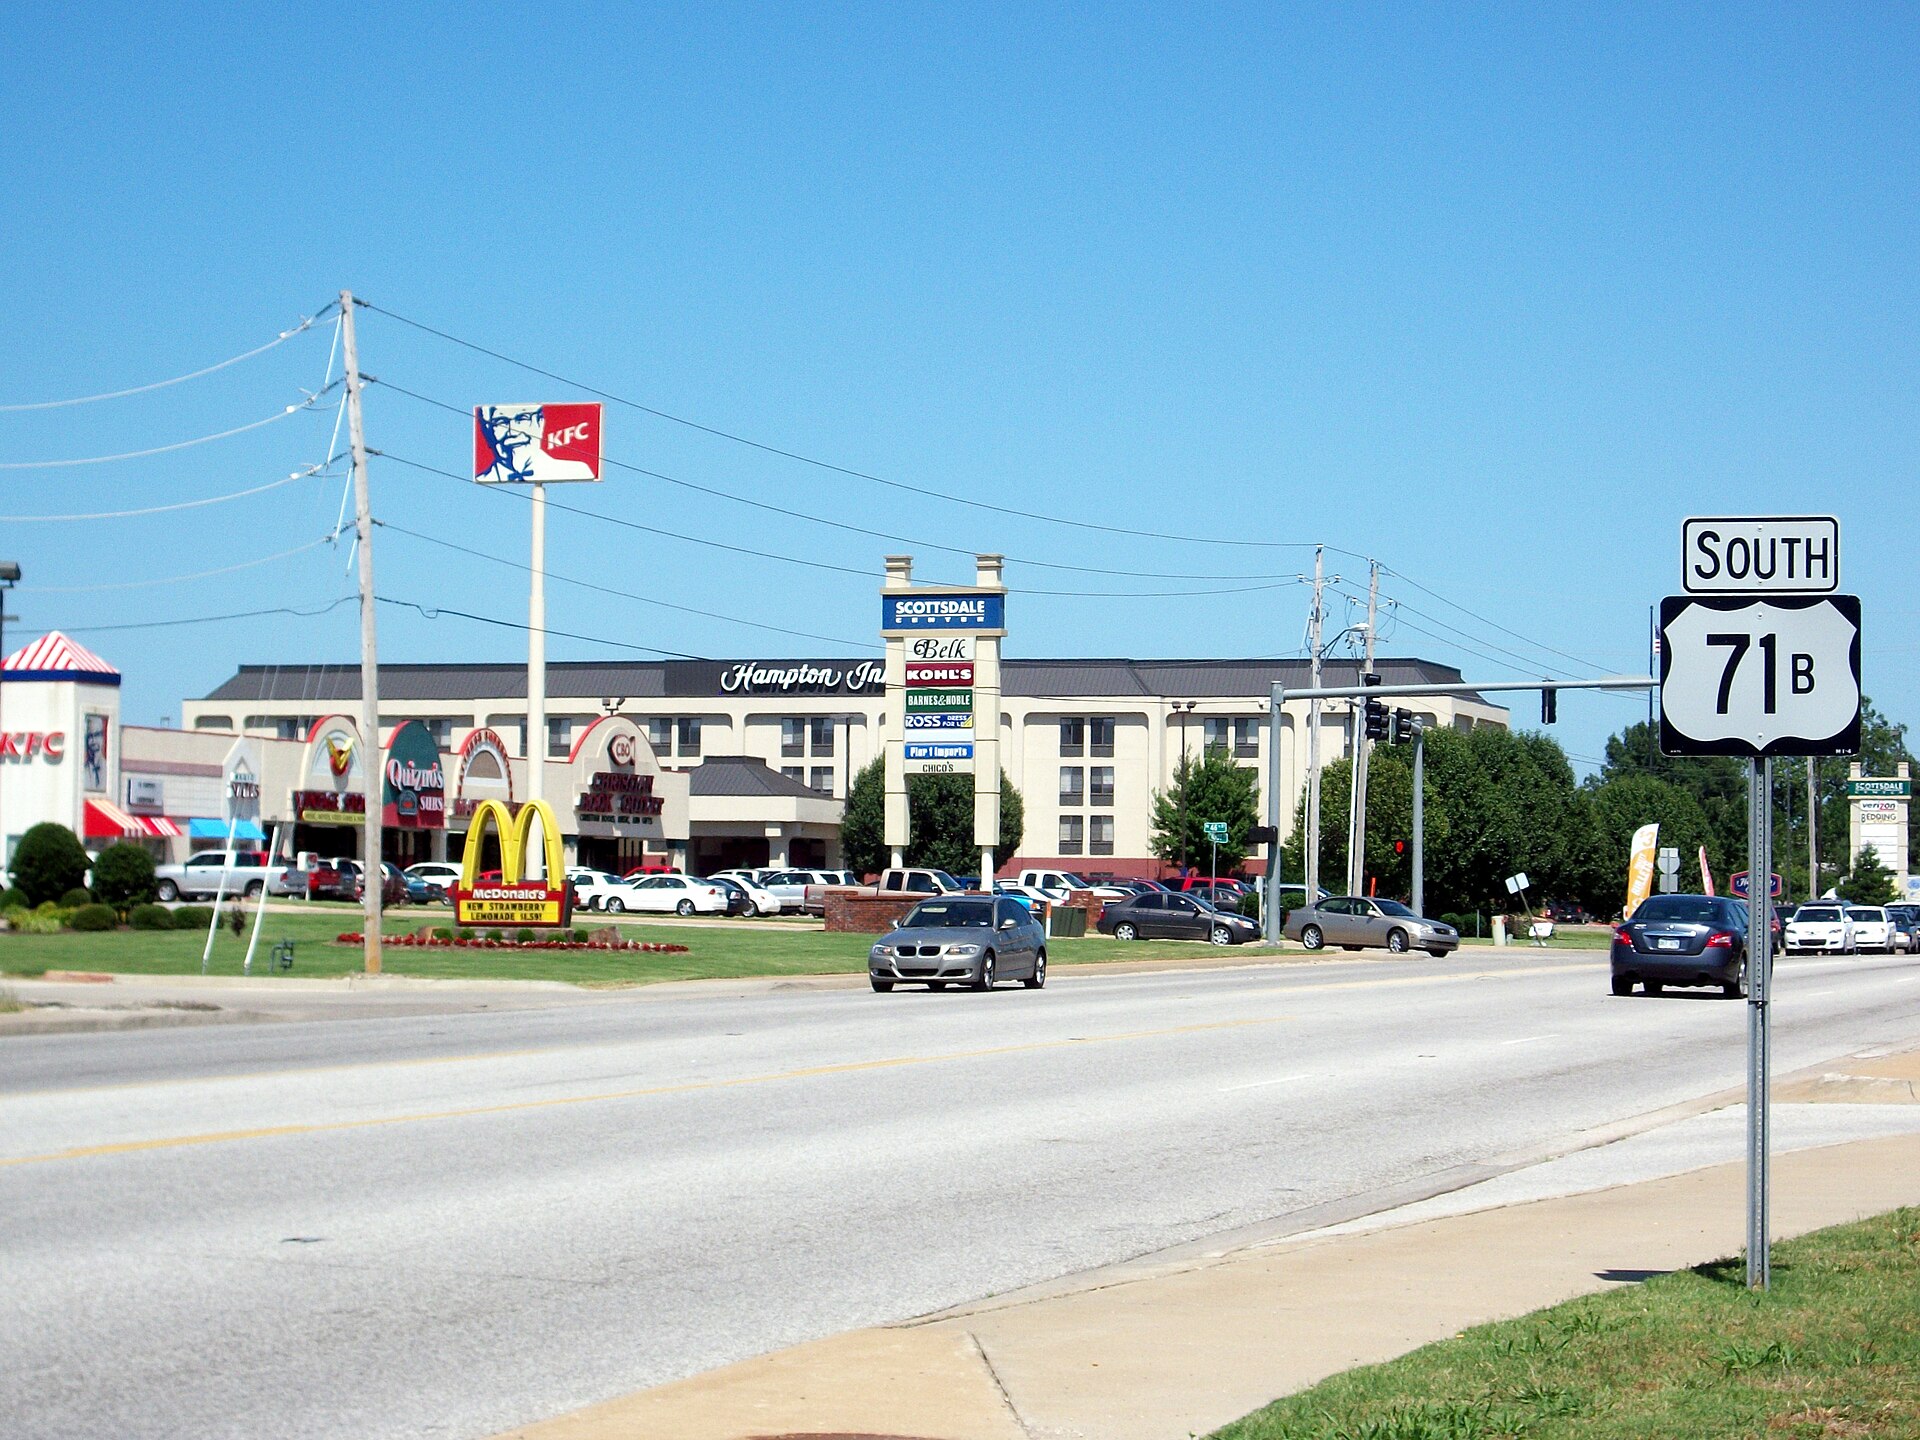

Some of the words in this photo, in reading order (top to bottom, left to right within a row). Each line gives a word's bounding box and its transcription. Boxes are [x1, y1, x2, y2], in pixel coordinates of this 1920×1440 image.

[547, 422, 589, 450] KFC
[1694, 530, 1829, 580] SOUTH
[895, 600, 986, 614] SCOTTSDALE
[913, 638, 966, 659] Belk
[720, 661, 842, 692] Hampton
[846, 661, 887, 690] In
[906, 669, 972, 680] KOHL'S
[905, 715, 941, 727] ROSS
[0, 731, 65, 757] KFC
[615, 742, 630, 756] CBO
[910, 746, 928, 757] Pier
[934, 746, 968, 758] Imports
[922, 761, 954, 772] CHICO'S
[1855, 782, 1904, 790] SCOTTSDALE
[419, 795, 443, 811] SUBS
[1862, 802, 1896, 810] verizon
[472, 888, 547, 900] McDonald's
[466, 902, 484, 910] NEW
[489, 902, 546, 911] STRAWBERRY
[470, 912, 515, 921] LEMONADE
